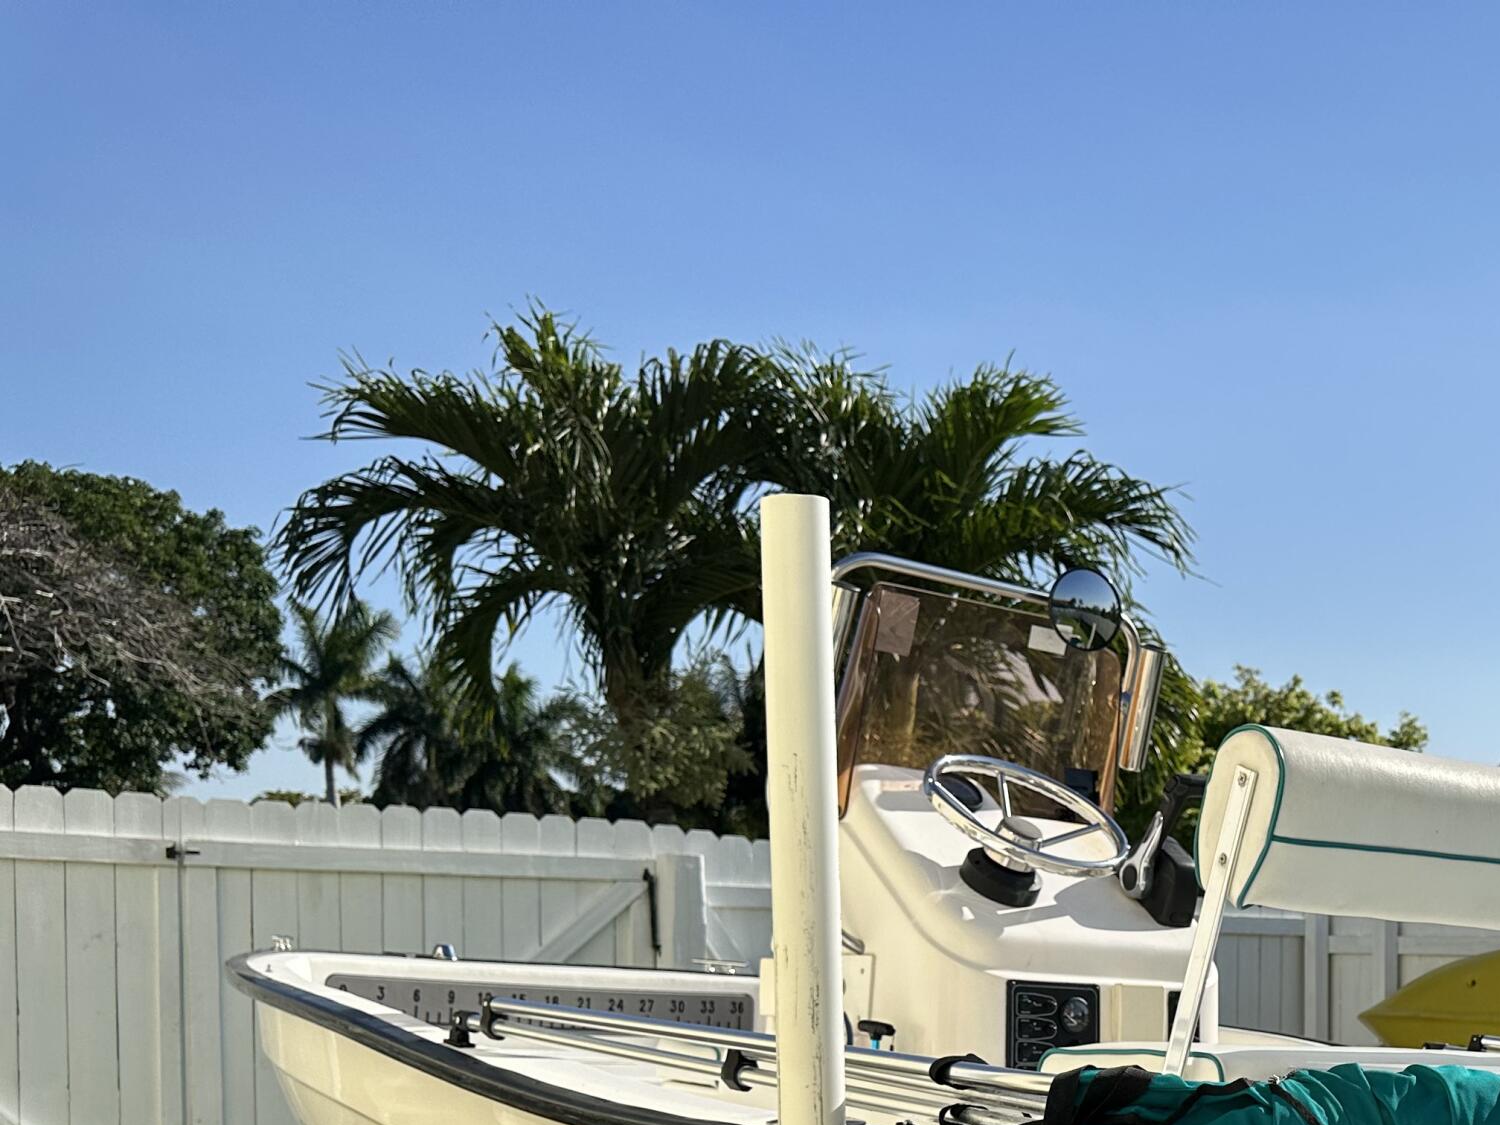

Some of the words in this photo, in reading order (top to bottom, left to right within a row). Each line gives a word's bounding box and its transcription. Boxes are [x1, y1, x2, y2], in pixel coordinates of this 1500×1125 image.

[377, 986, 385, 1000] 3
[413, 989, 420, 1002] 6
[448, 990, 455, 1004] 9
[577, 998, 591, 1009] 21
[609, 999, 624, 1012] 24
[640, 1000, 655, 1012] 27
[670, 1001, 685, 1013] 30
[701, 1002, 715, 1013] 33
[730, 1002, 744, 1014] 36
